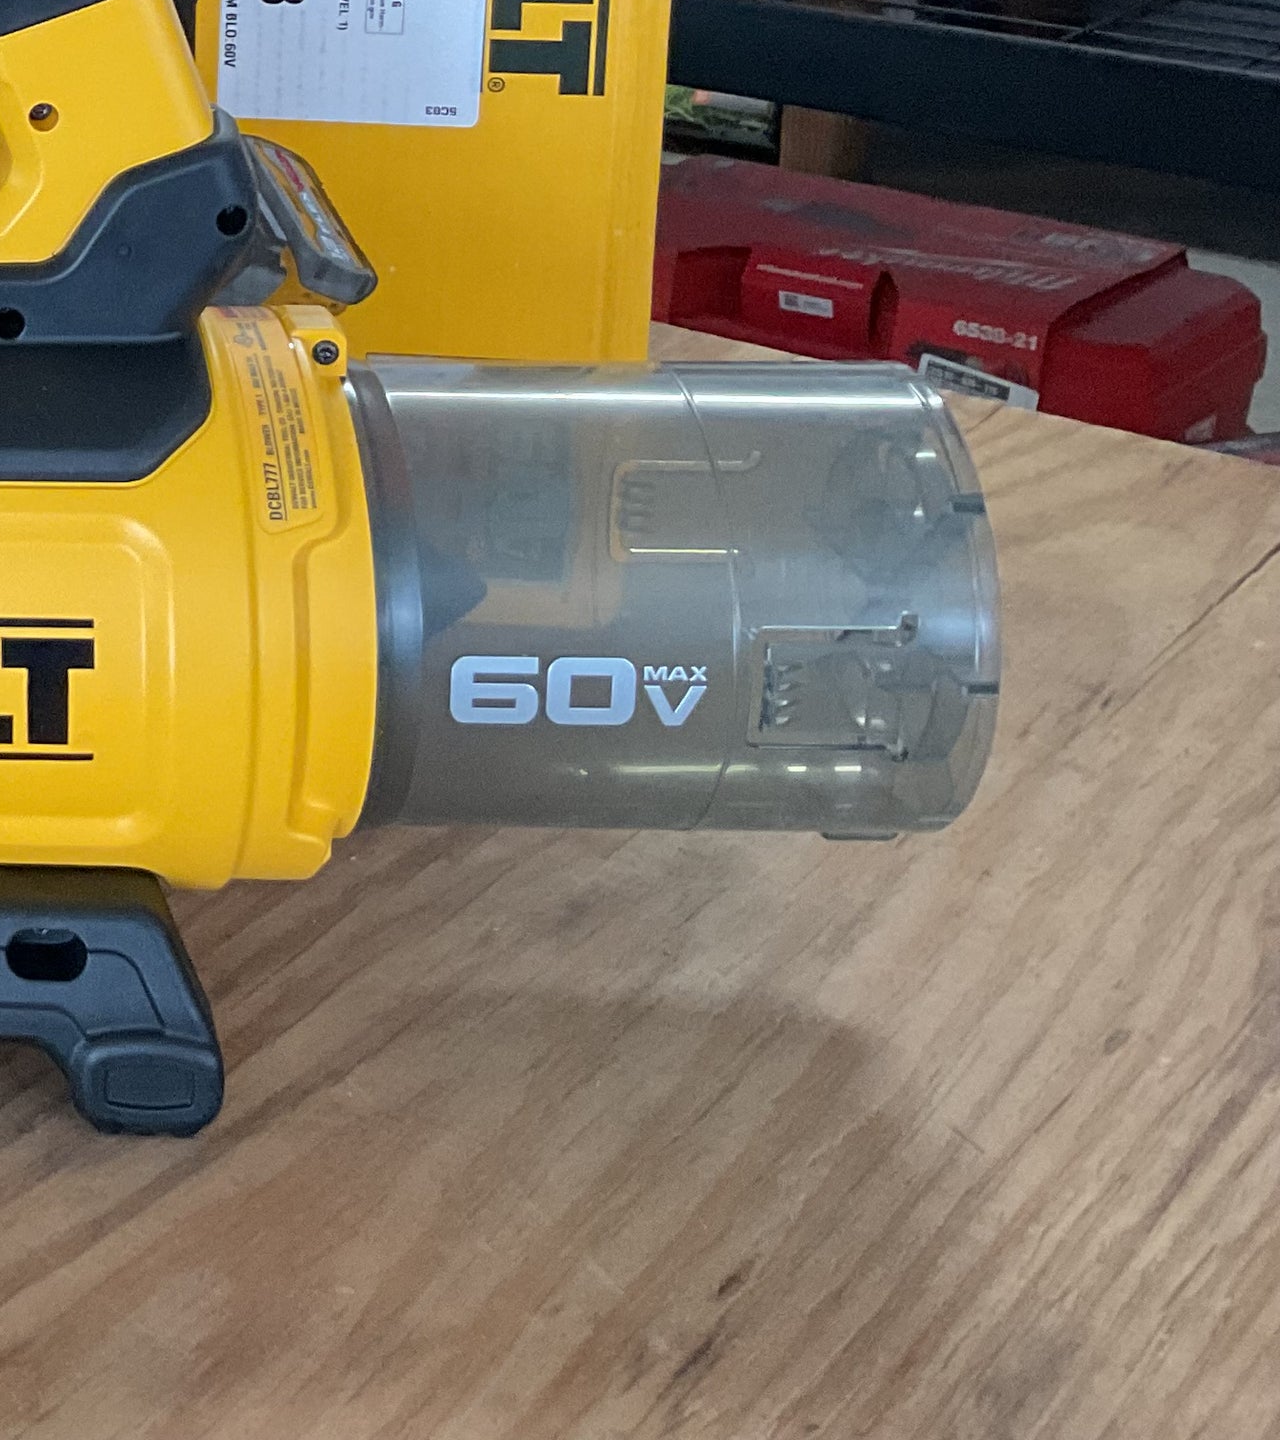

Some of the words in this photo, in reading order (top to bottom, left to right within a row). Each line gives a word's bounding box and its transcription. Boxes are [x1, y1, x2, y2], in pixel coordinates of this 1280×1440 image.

[222, 12, 238, 68] BLO:60V
[334, 20, 347, 32] 1)
[263, 462, 283, 521] DCBL777
[449, 654, 708, 727] 60V
[642, 665, 708, 683] MAX
